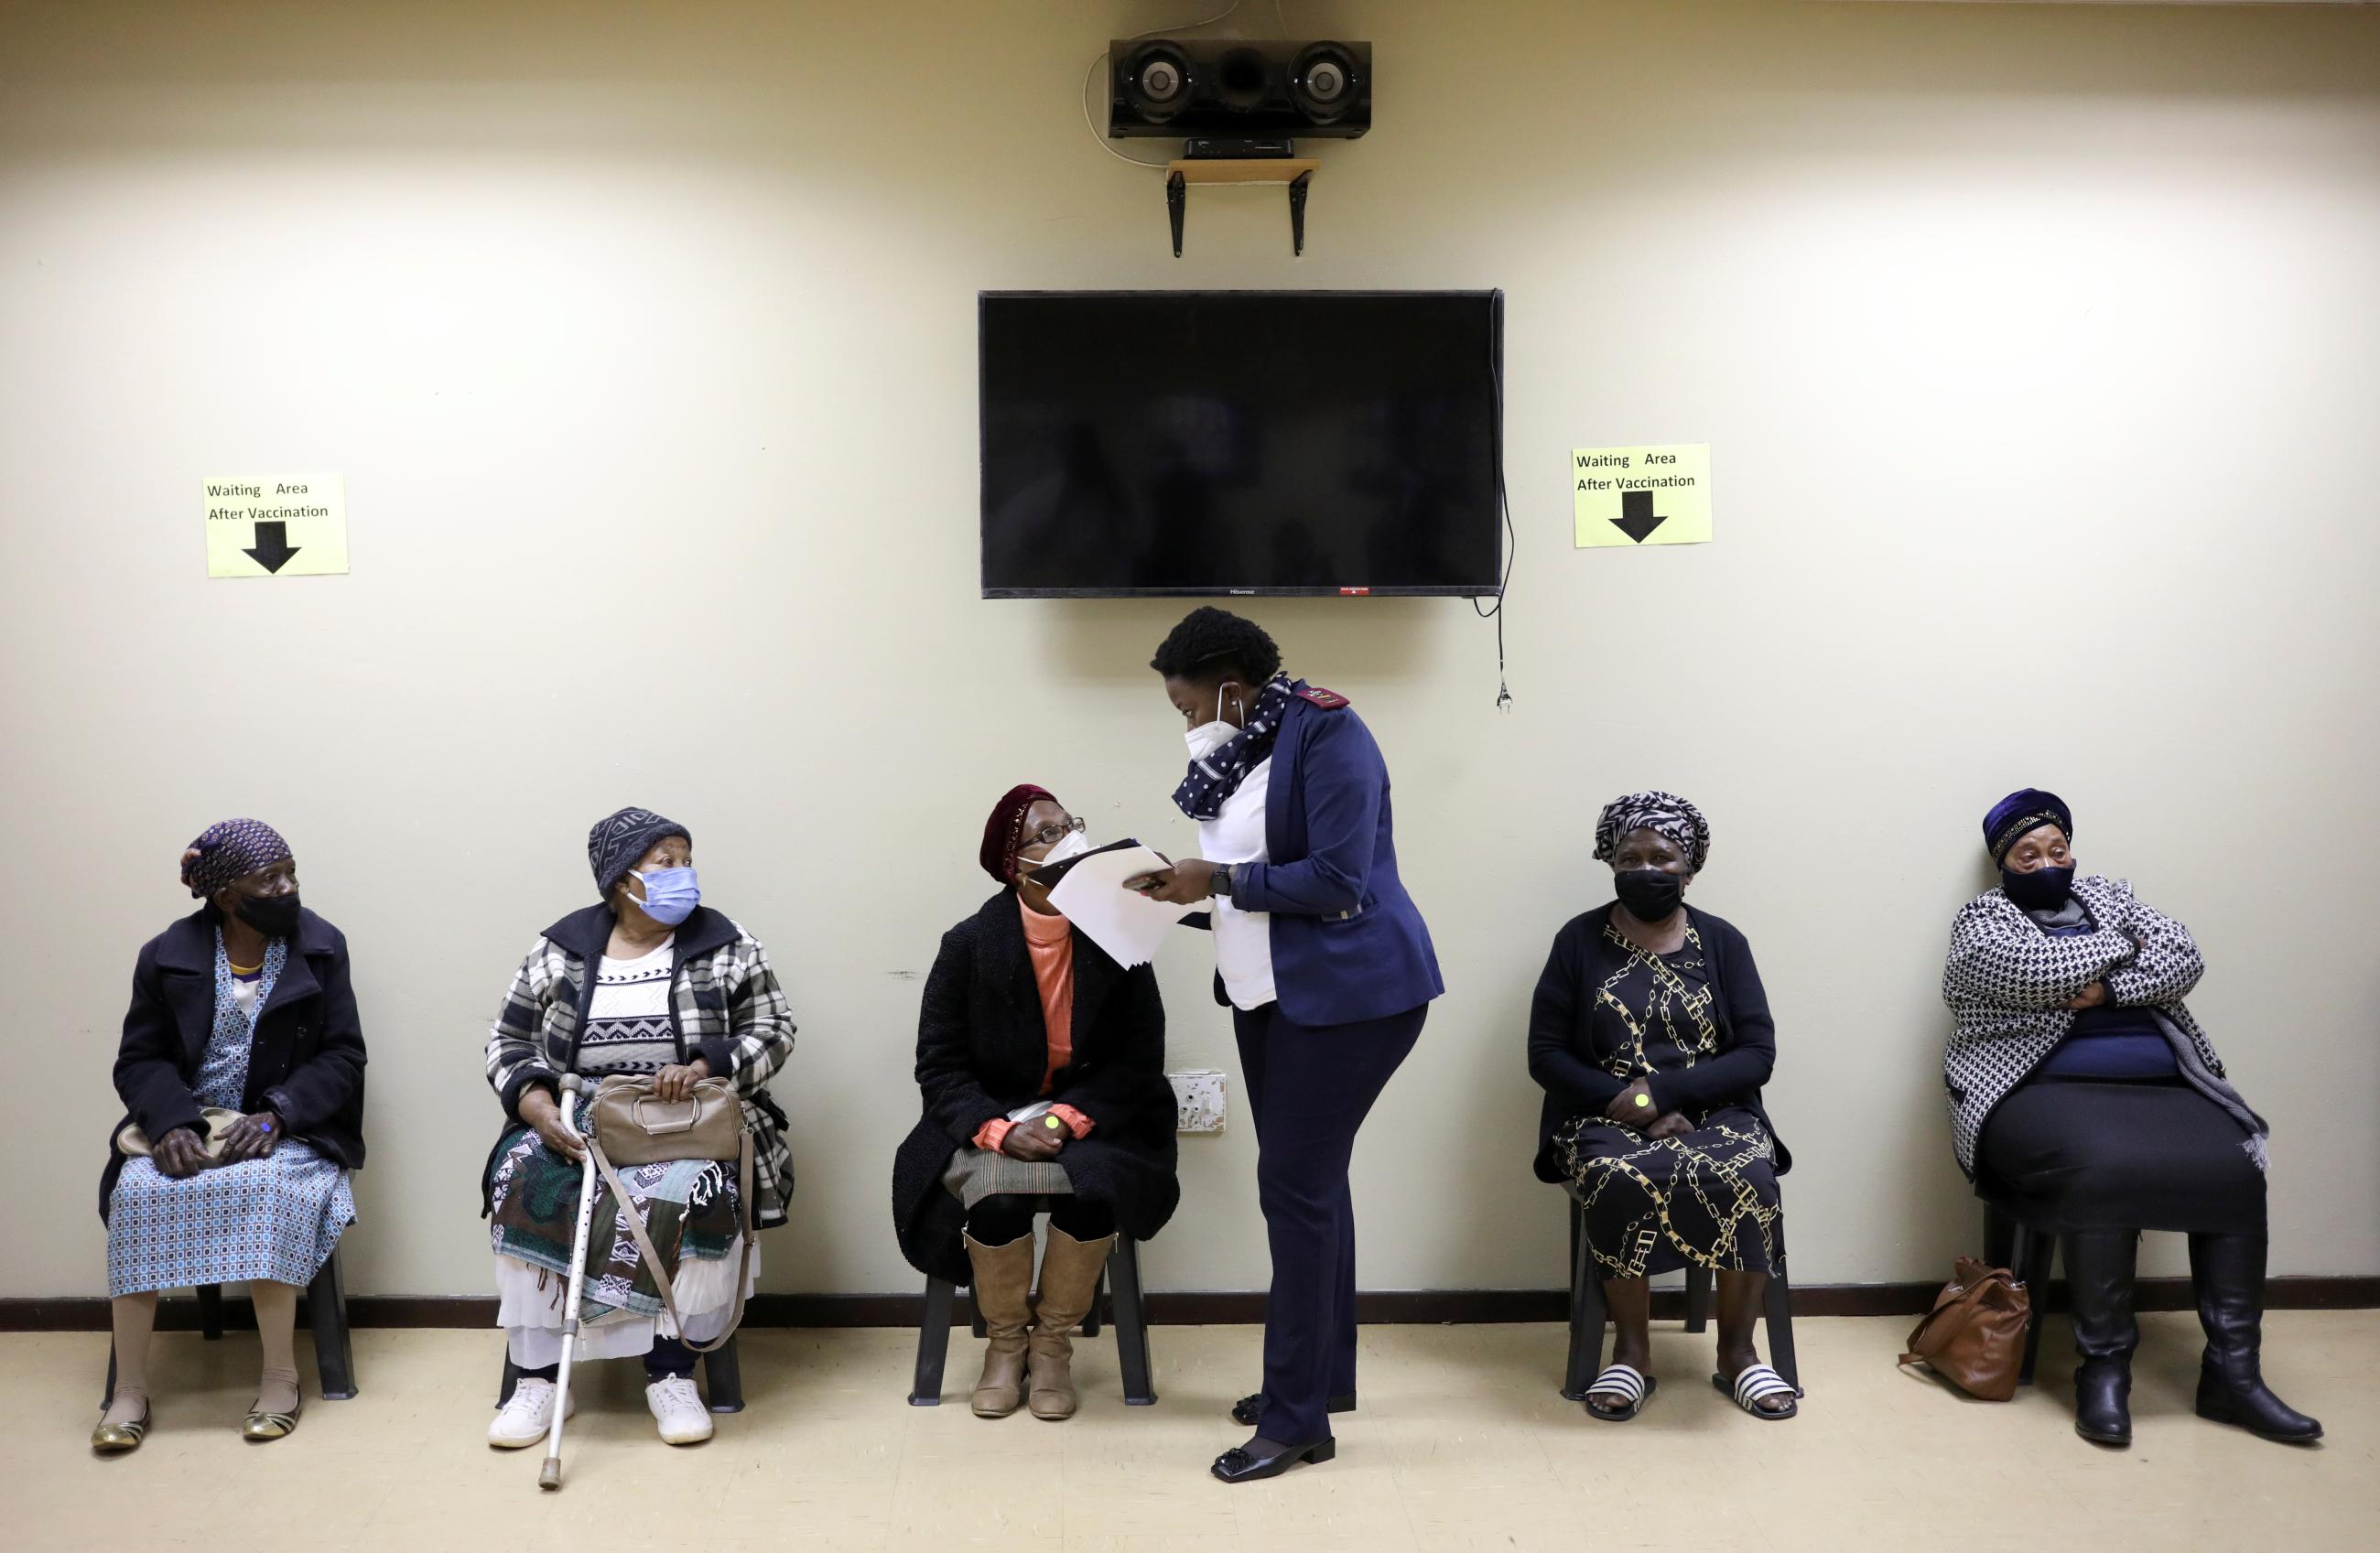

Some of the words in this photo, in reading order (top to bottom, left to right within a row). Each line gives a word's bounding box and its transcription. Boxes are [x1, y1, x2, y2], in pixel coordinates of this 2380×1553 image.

[1576, 455, 1629, 468] Waiting
[1644, 453, 1676, 465] Area
[207, 484, 261, 498] Waiting
[276, 483, 308, 494] Area
[1577, 478, 1612, 491] After
[1616, 475, 1695, 490] Vaccination
[209, 507, 244, 520] After
[247, 505, 329, 519] Vaccination
